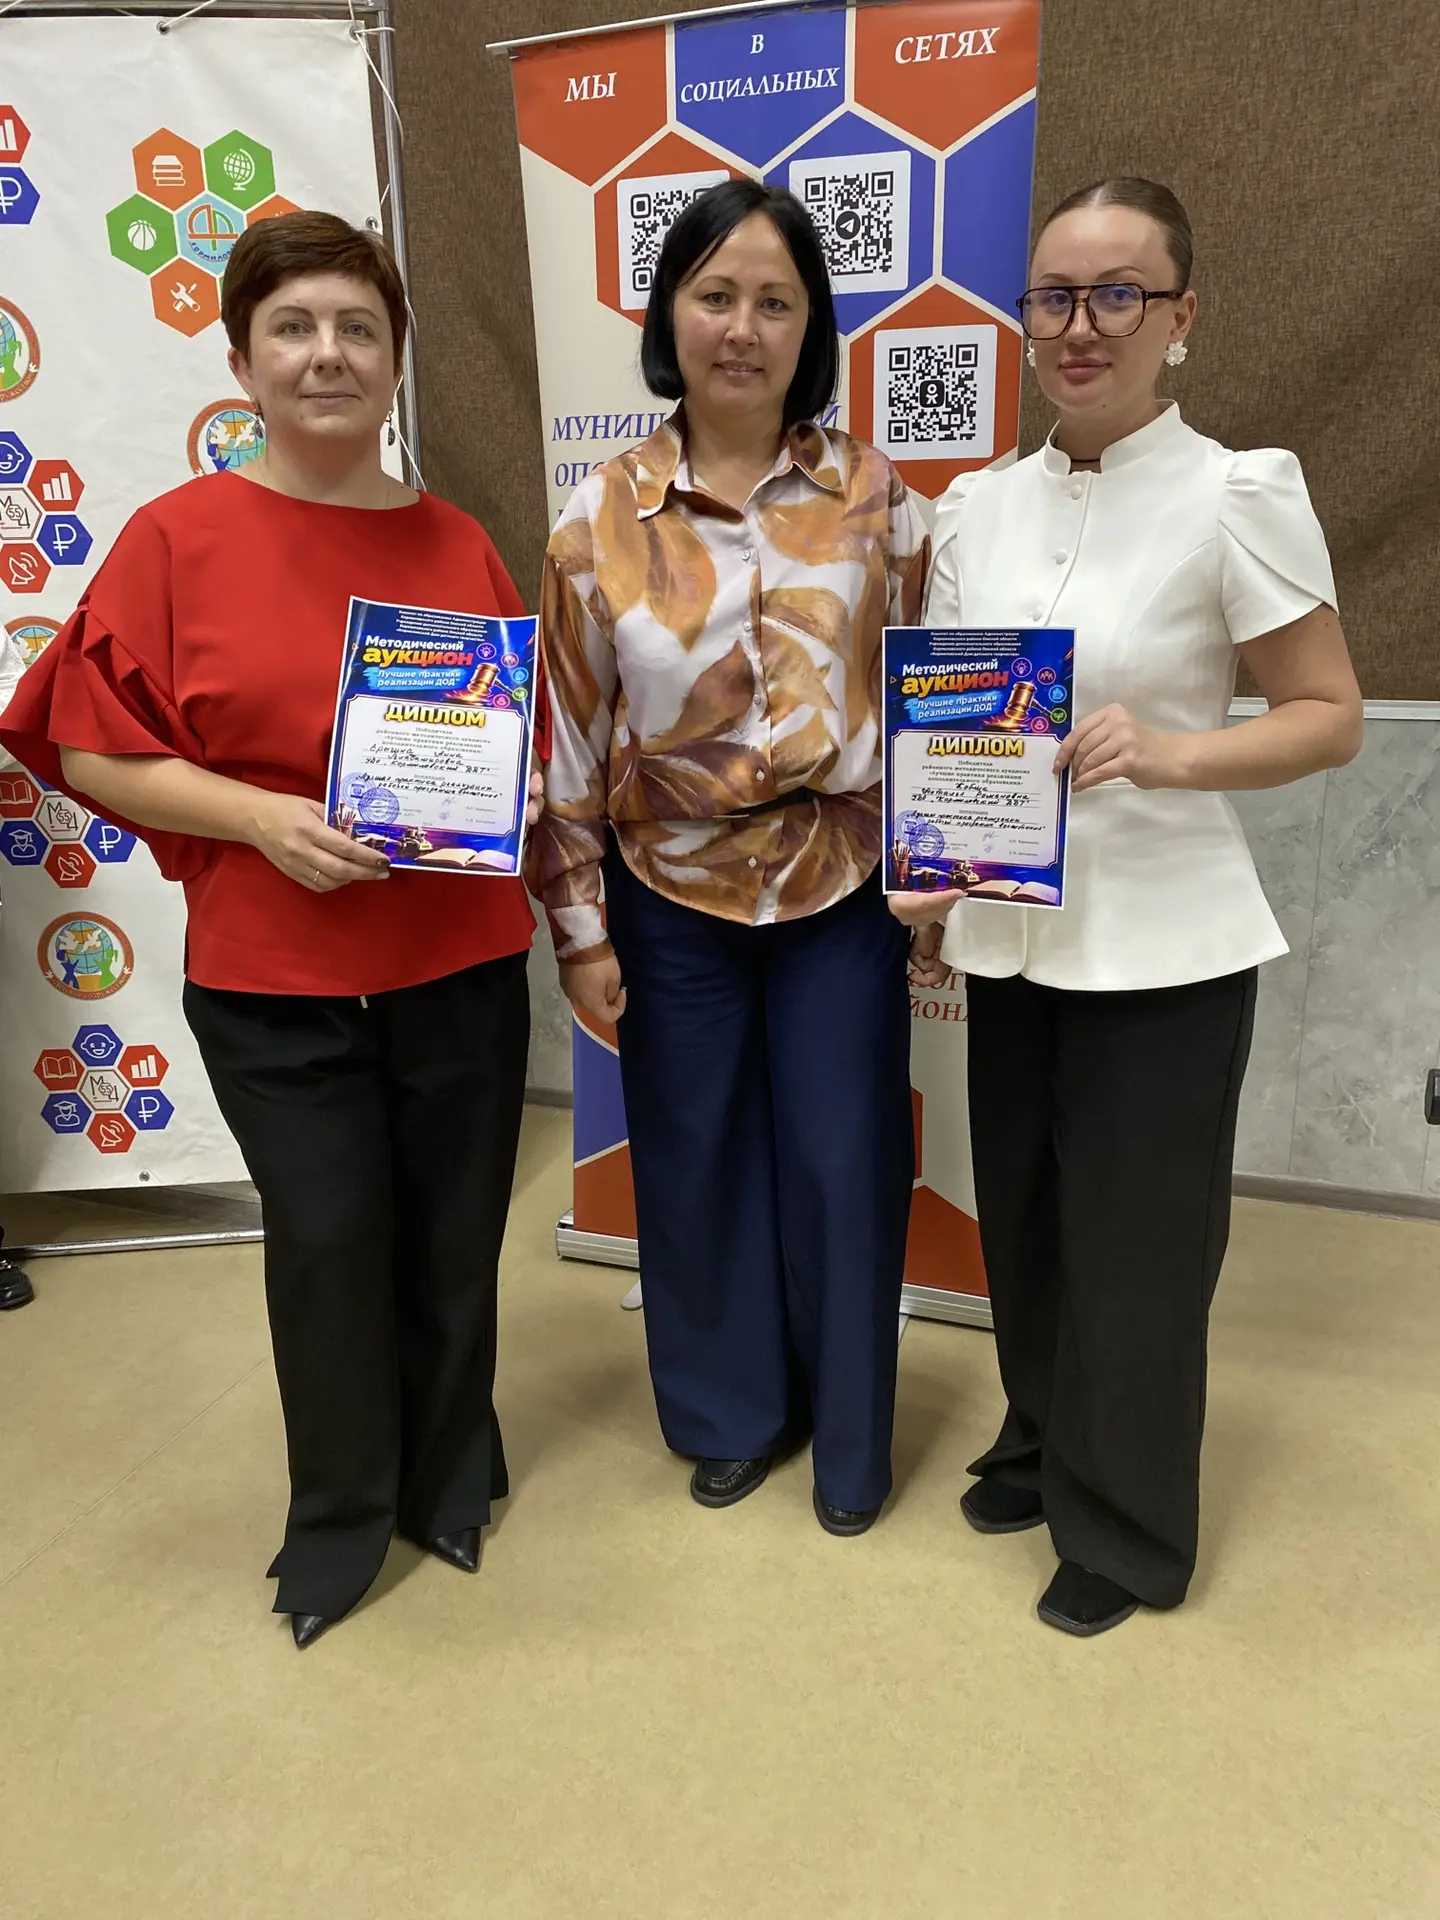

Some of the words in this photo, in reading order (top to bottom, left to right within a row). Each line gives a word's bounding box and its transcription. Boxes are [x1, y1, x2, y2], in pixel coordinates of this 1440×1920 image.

[750, 33, 764, 54] В
[895, 27, 1000, 64] СЕТЯХ
[564, 71, 617, 103] МЫ
[680, 67, 840, 103] СОЦИАЛЬНЫХ
[555, 461, 604, 487] ОП
[365, 635, 464, 651] Методический
[362, 647, 473, 667] аукцион
[902, 658, 998, 676] Методический
[377, 677, 434, 687] реализации
[419, 670, 460, 679] практики
[901, 671, 1009, 698] аукцион
[956, 695, 997, 706] практики
[384, 703, 486, 727] ДИПЛОМ
[918, 707, 971, 719] реализации
[928, 735, 1024, 756] ДИПЛОМ
